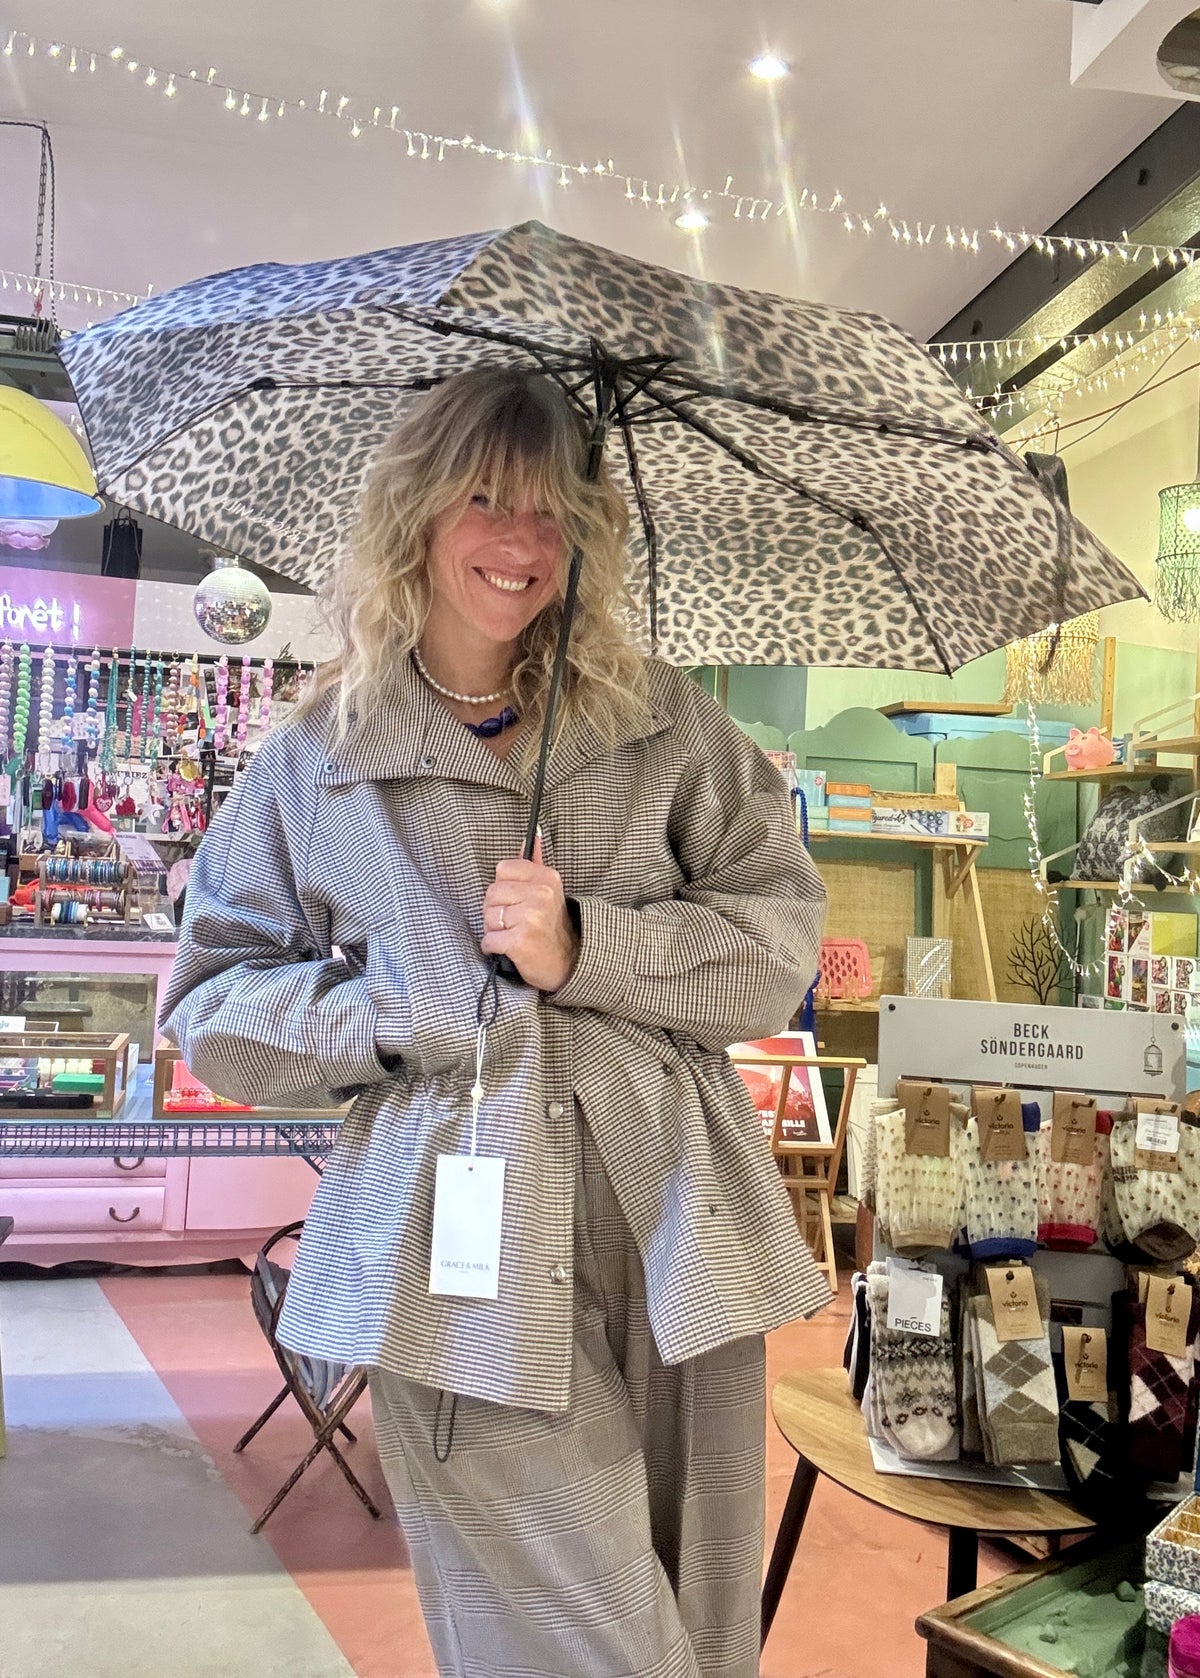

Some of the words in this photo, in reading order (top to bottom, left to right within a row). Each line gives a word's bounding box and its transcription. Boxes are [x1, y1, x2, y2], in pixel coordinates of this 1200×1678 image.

[1014, 1023, 1049, 1039] BECK
[981, 1036, 1084, 1060] SÖNDERGAARD
[440, 1260, 465, 1269] GRACE
[894, 1317, 932, 1333] PIECES
